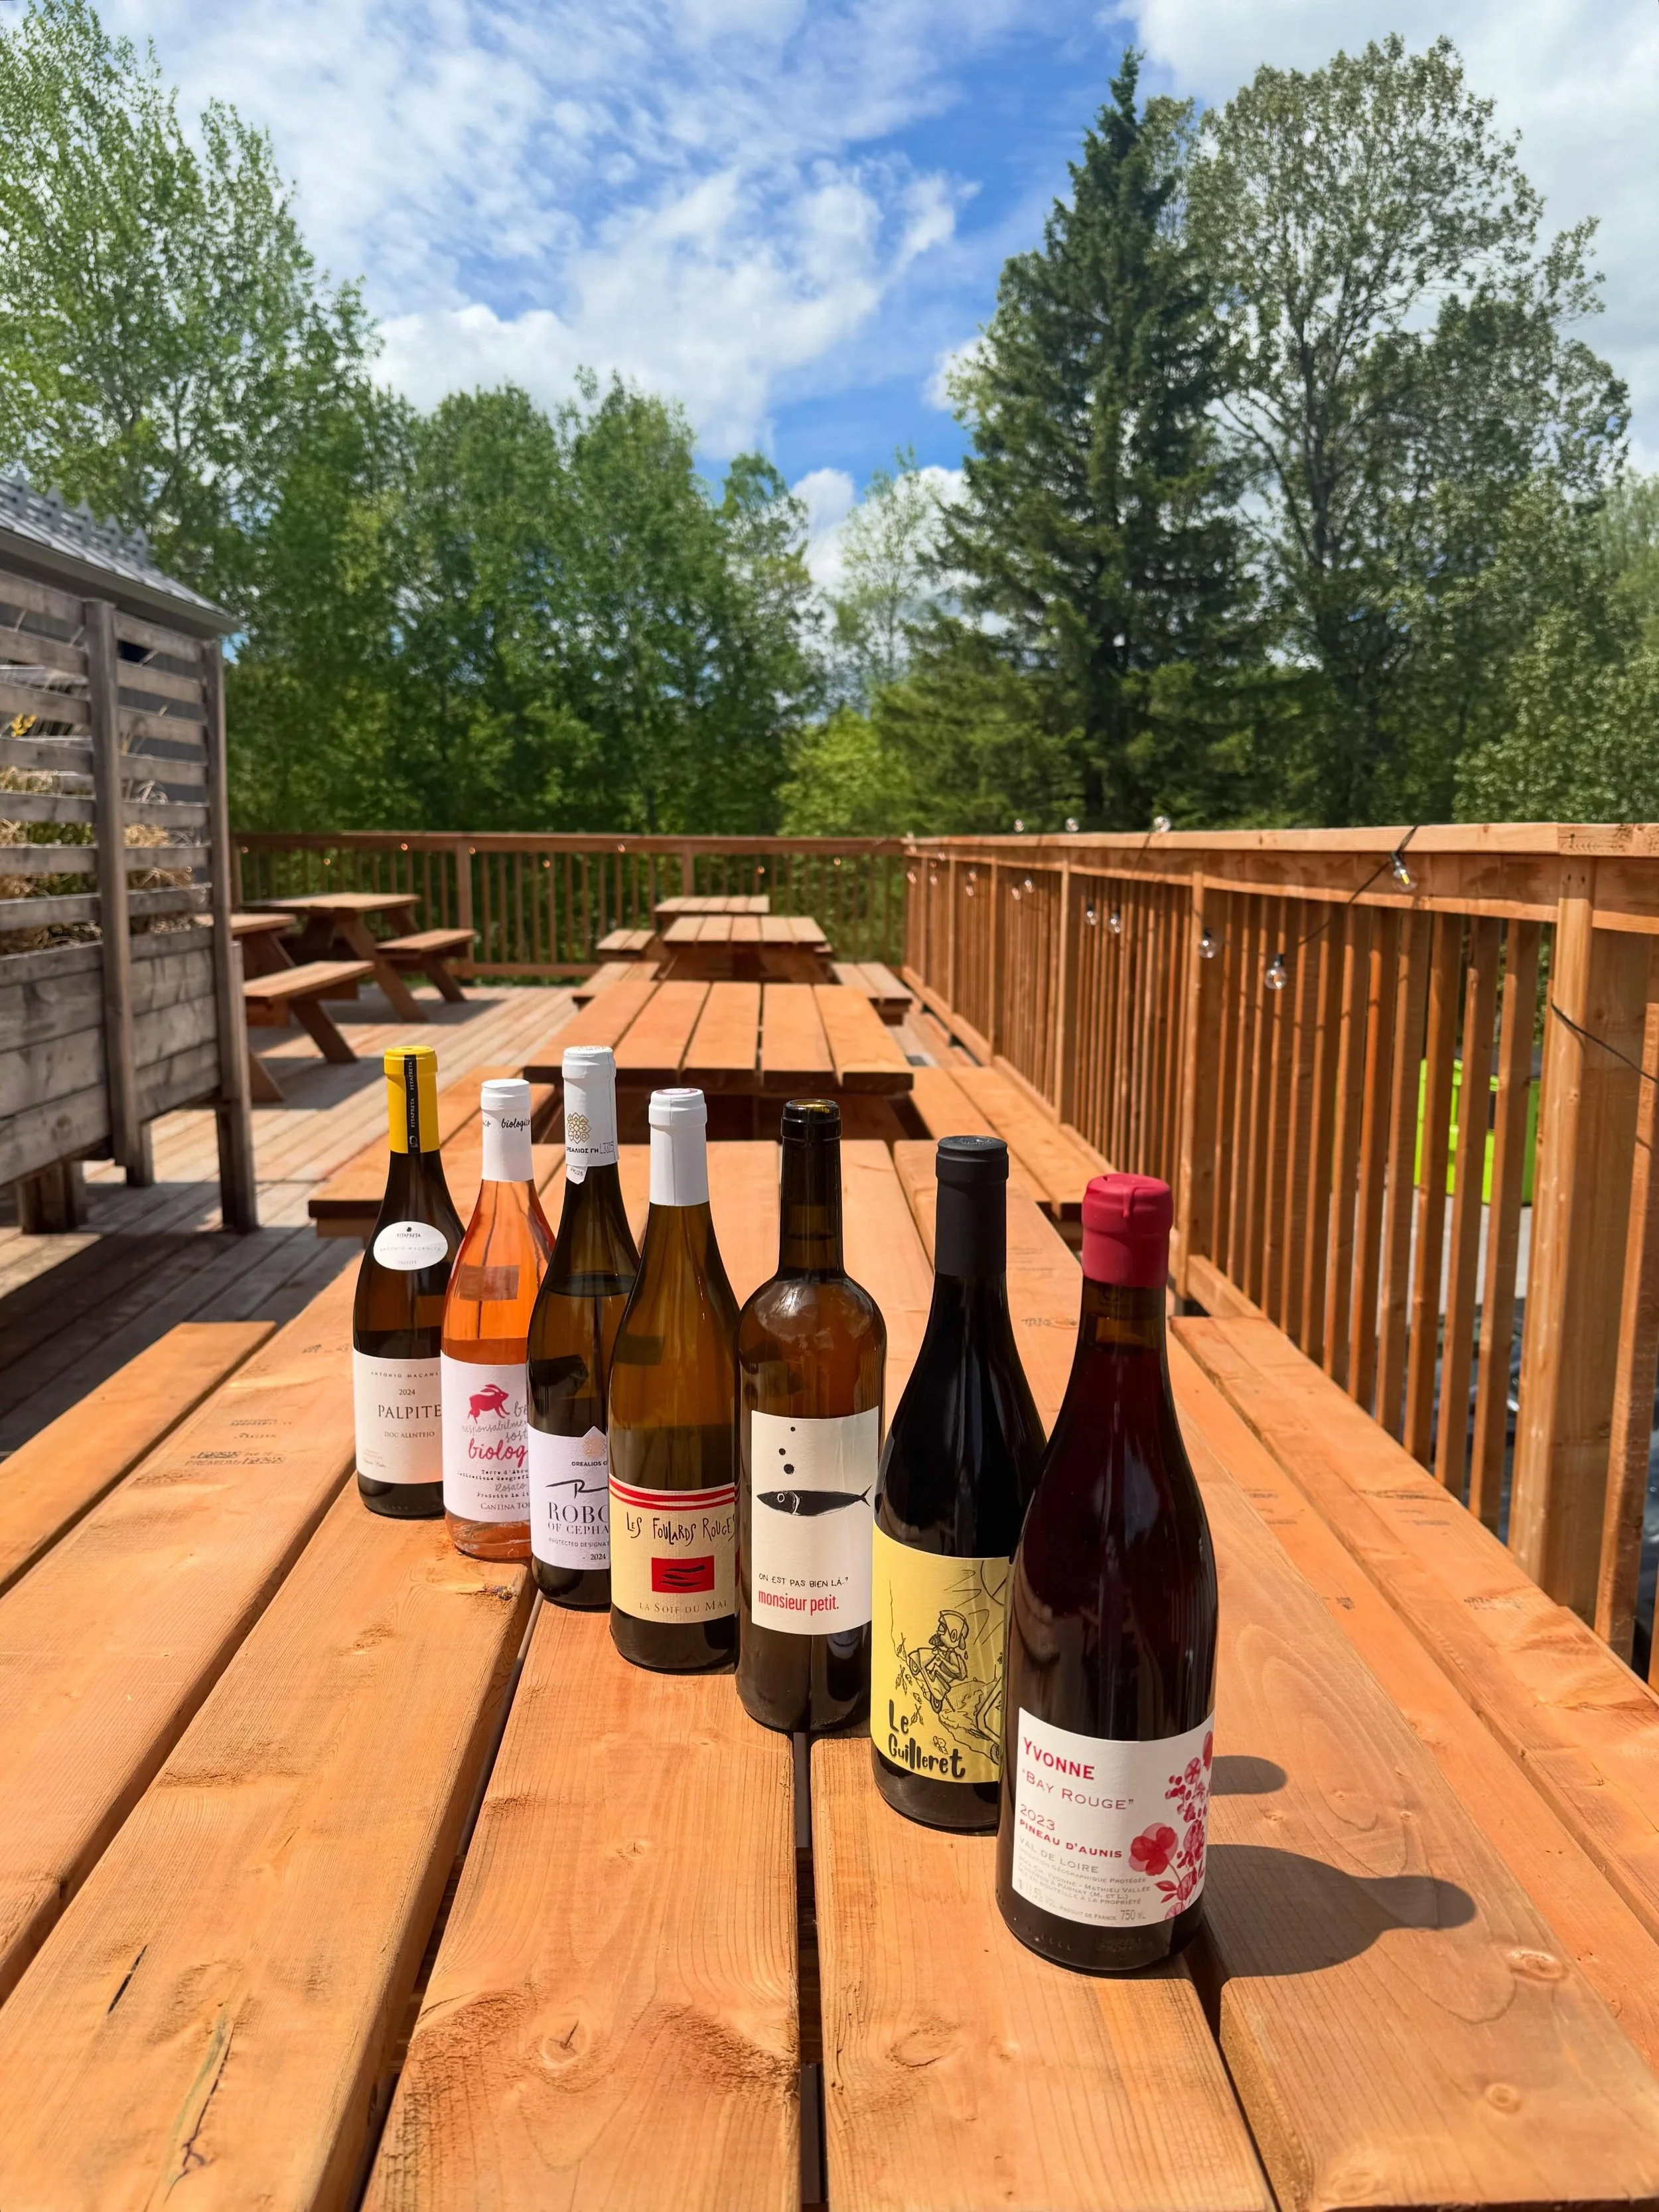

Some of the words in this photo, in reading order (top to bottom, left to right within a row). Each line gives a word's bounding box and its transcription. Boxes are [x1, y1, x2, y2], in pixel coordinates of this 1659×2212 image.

[378, 1404, 442, 1420] PALPITE
[547, 1521, 561, 1532] OF
[549, 1538, 579, 1547] PROTECTED
[758, 1573, 768, 1582] ON
[771, 1576, 786, 1585] EST
[790, 1579, 806, 1587] PAS
[758, 1590, 808, 1611] monsieur
[810, 1594, 839, 1616] petit.
[889, 1699, 909, 1734] Le
[888, 1733, 966, 1779] Guilleret
[1023, 1736, 1095, 1781] YVONNE
[1019, 1803, 1055, 1831] 2023
[1019, 1818, 1060, 1846] PINEAU
[1065, 1842, 1123, 1859] D'AUNIS
[1019, 1834, 1037, 1854] VAL
[1041, 1849, 1056, 1862] DE
[1060, 1858, 1100, 1874] LOIRE
[1084, 1884, 1120, 1893] MATHIEU
[1120, 1909, 1136, 1921] 750
